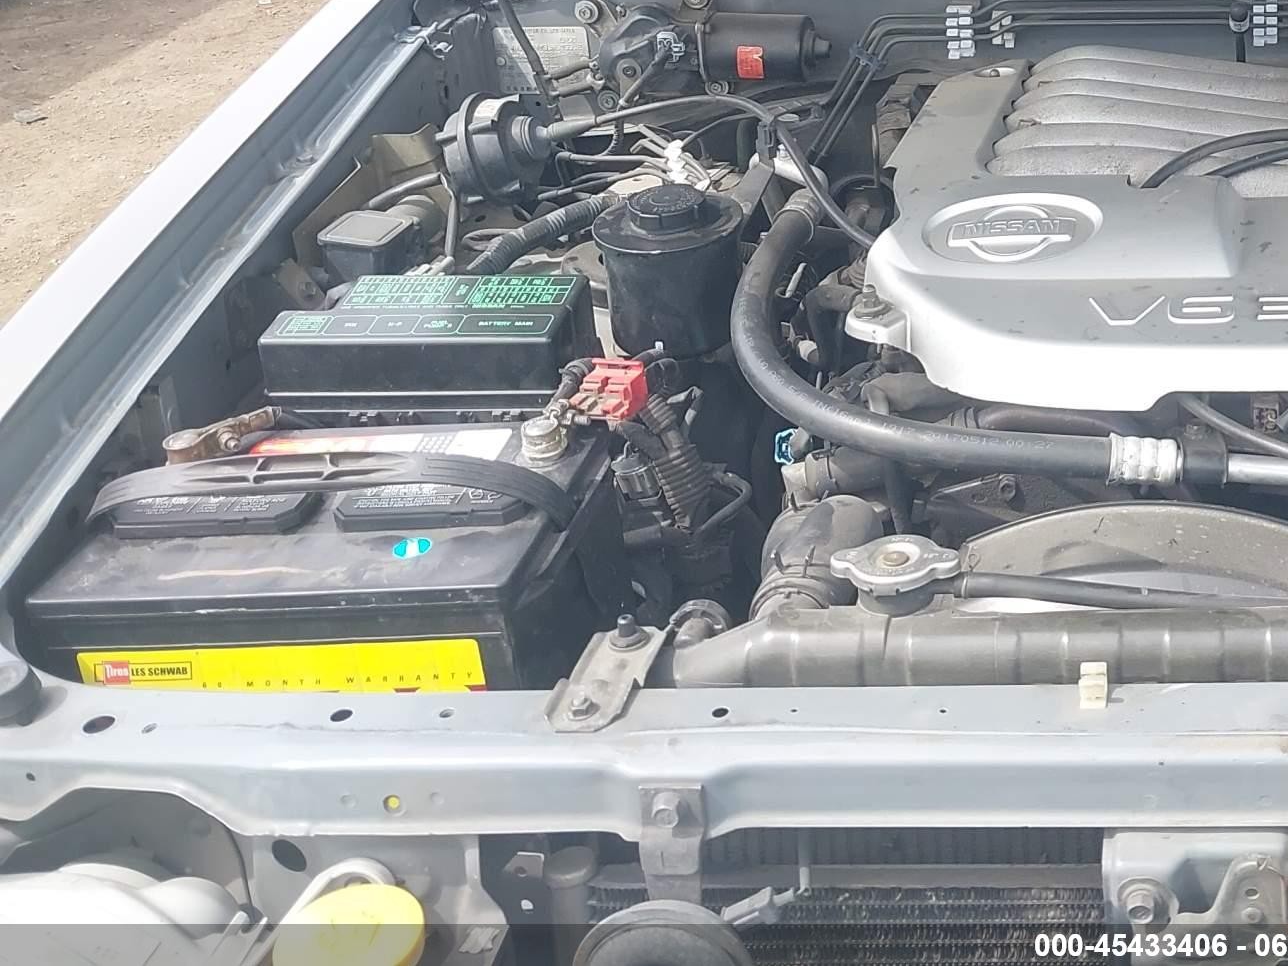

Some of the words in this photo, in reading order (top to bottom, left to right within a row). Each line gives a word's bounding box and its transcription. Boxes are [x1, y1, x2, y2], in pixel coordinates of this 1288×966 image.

[964, 218, 1063, 236] NISSAN
[1088, 292, 1235, 326] V6
[105, 664, 129, 678] Tires
[131, 667, 146, 676] LES
[148, 666, 188, 676] SCHWAB
[246, 679, 321, 688] MONTH
[346, 672, 473, 684] WARRANTY
